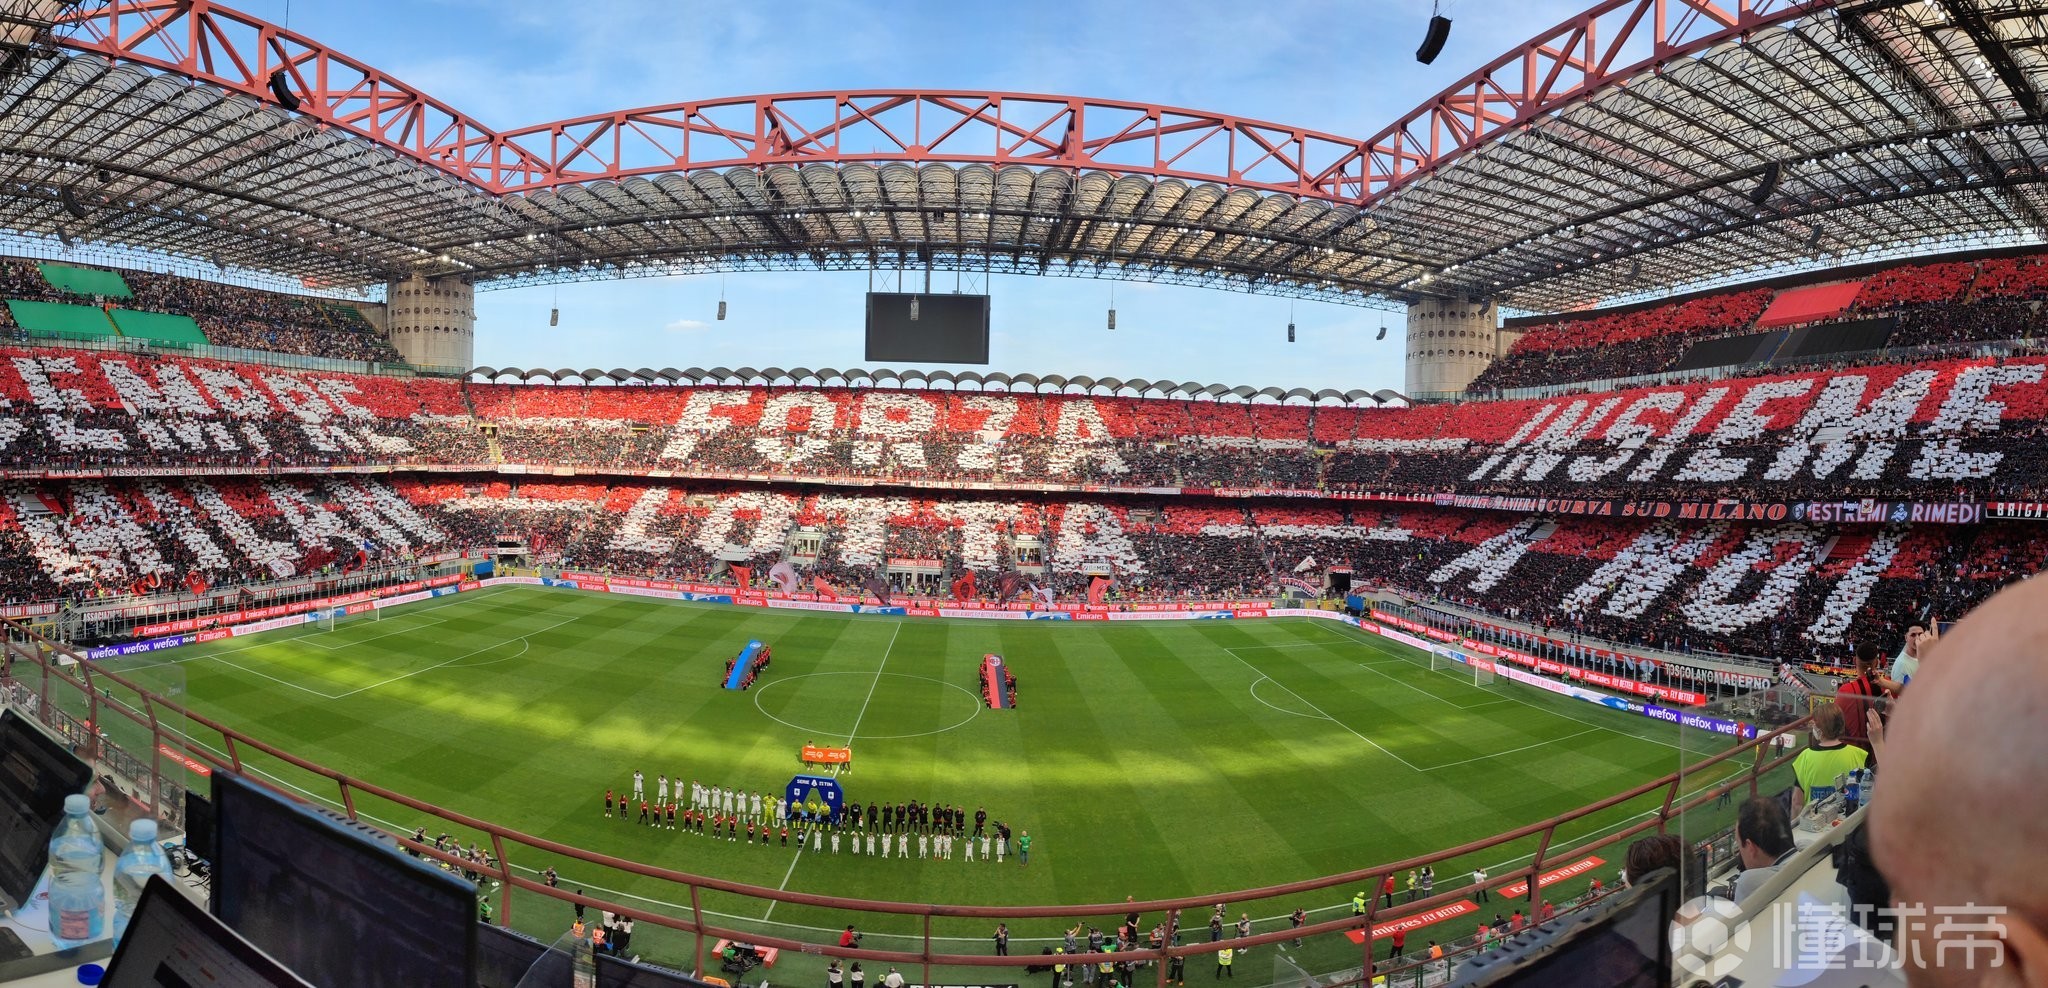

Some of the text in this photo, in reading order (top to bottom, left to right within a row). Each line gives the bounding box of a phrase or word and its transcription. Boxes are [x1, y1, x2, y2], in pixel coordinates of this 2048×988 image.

[661, 388, 1130, 474] FORZA
[1468, 363, 2046, 482] INSIEME
[112, 468, 183, 476] ASSOCIAZIONE
[1334, 490, 1436, 502] FOSSA DEI LEONI
[1547, 500, 1787, 520] CURVA SUD MILANO
[1912, 504, 1981, 522] RIMEDI
[1998, 502, 2048, 518] BRIGA
[606, 486, 1146, 575] LOTTA
[1560, 520, 1906, 645] NOI
[289, 603, 309, 612] Emirates
[737, 598, 763, 606] Emirates
[246, 610, 267, 618] Emirates
[144, 626, 170, 634] Emirates
[199, 630, 227, 641] Emirates
[91, 647, 119, 659] wefox
[123, 643, 150, 654] wefox
[153, 638, 179, 650] wefox
[1497, 648, 1517, 660] Emirates
[1584, 671, 1610, 684] Emirates
[1619, 679, 1634, 690] BETTER
[1714, 672, 1771, 690] MADERNO
[1678, 691, 1695, 702] BETTER
[1648, 708, 1677, 722] wefox
[1681, 714, 1711, 729] wefox
[1716, 722, 1750, 737] wefx
[1559, 867, 1574, 878] FLY
[1572, 860, 1594, 873] BETTER
[1421, 911, 1438, 922] FLY
[1438, 904, 1466, 918] BETTER
